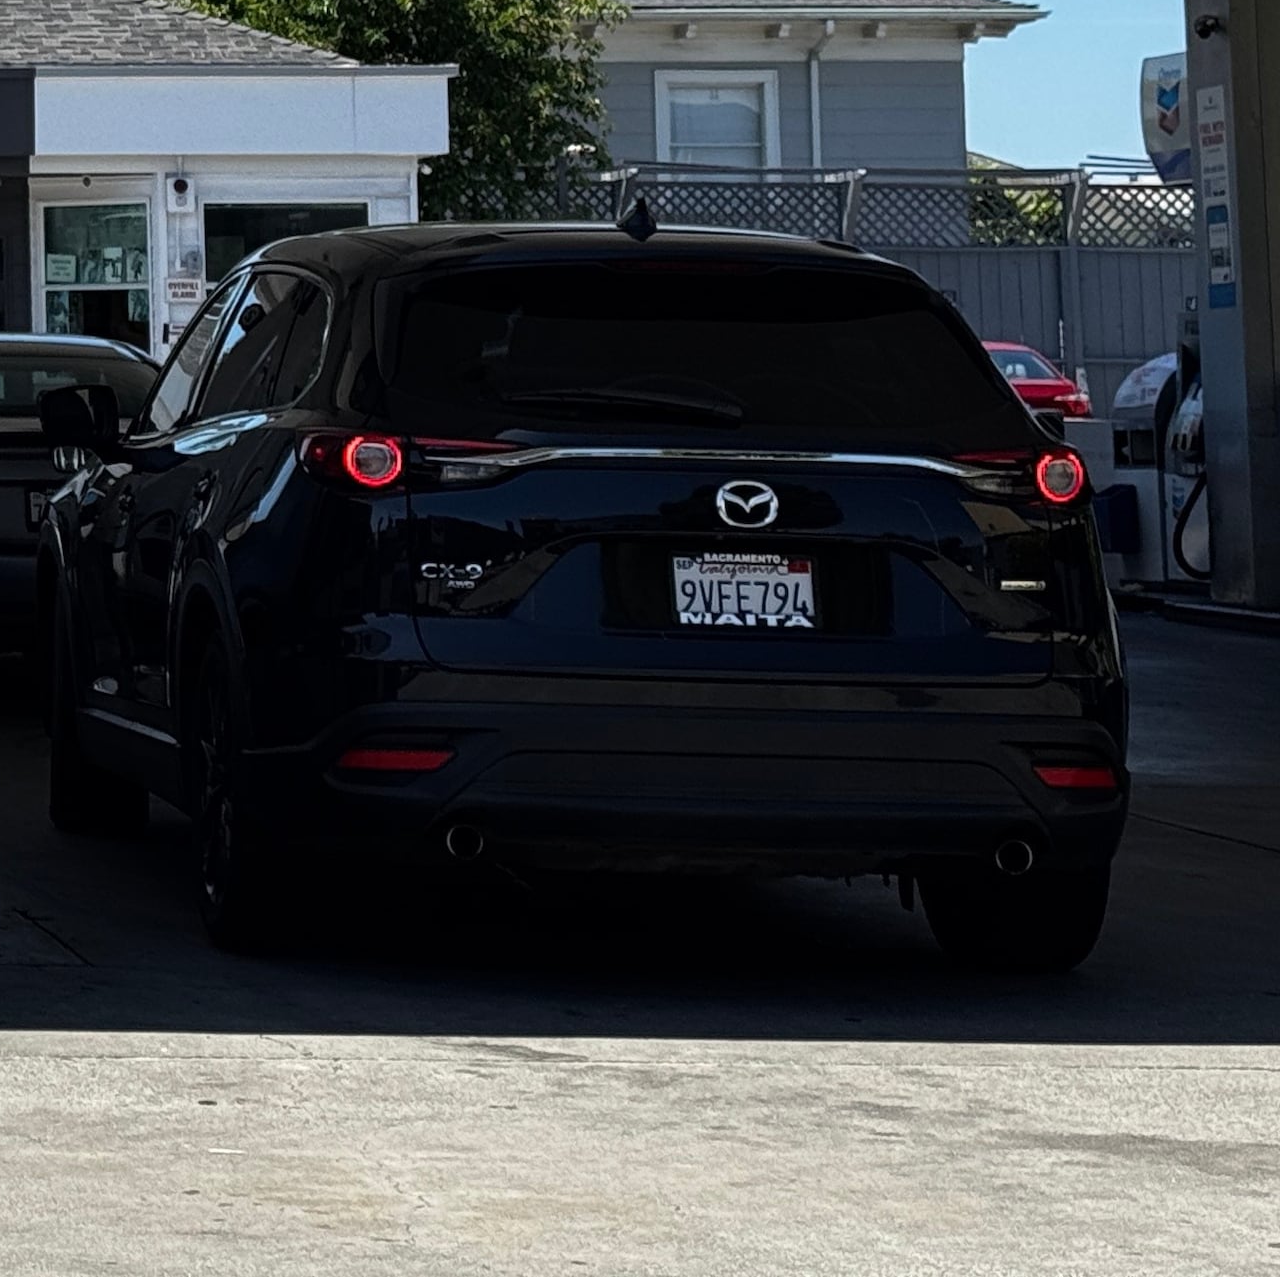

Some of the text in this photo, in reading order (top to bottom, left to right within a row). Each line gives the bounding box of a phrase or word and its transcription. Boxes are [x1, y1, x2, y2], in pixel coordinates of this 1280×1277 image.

[703, 552, 781, 564] SACRAMENTO
[421, 562, 483, 580] CX-9
[679, 612, 815, 628] MAITA
